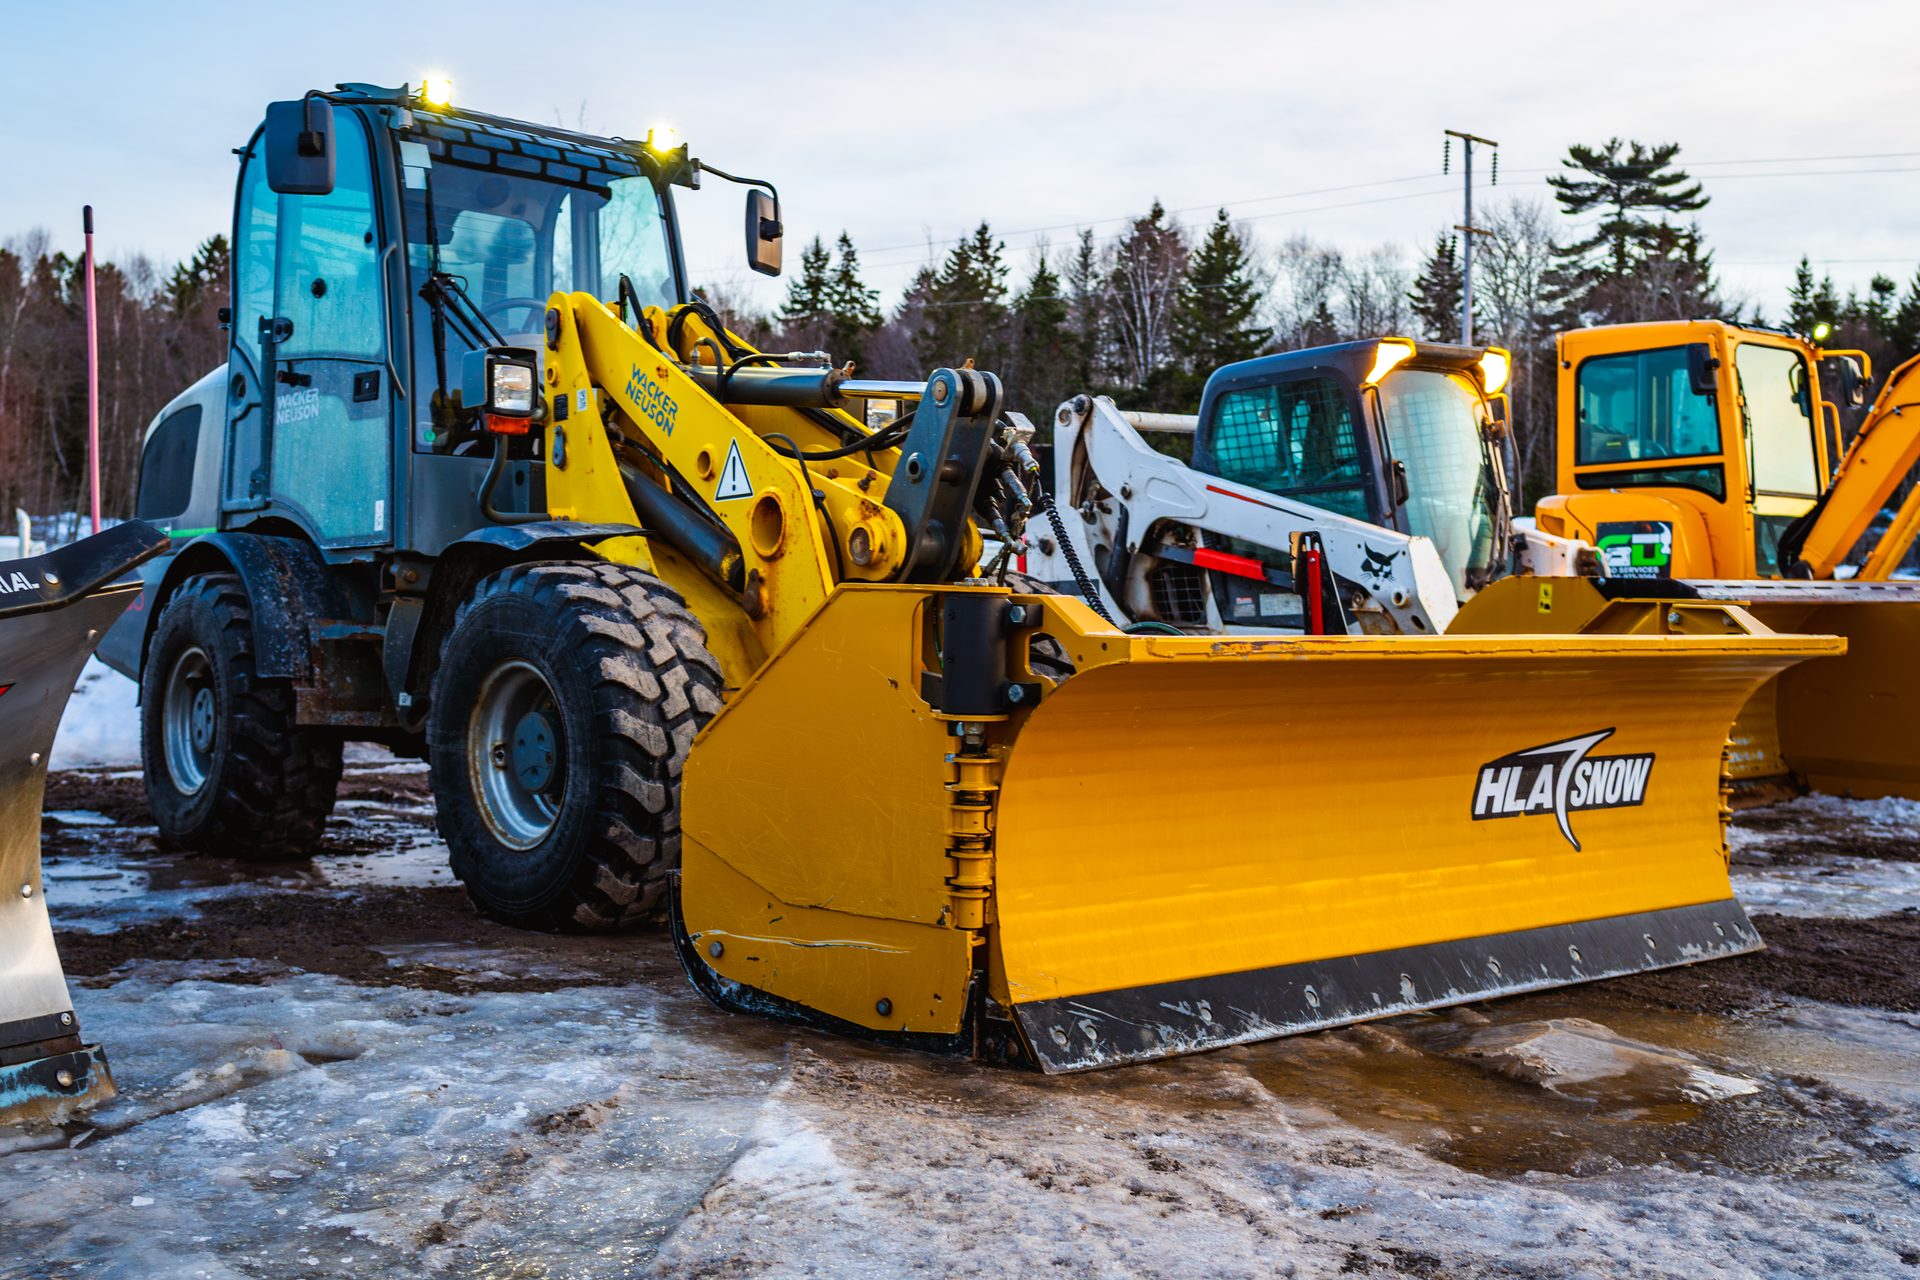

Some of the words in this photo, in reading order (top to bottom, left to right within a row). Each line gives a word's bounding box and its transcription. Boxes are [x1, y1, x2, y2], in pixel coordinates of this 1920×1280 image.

[276, 387, 319, 410] WACKER
[625, 380, 675, 437] NEUSON
[632, 362, 679, 421] WACKER
[276, 403, 319, 425] NEUSON
[1619, 566, 1659, 574] SERVICES
[1474, 763, 1554, 816] HLA
[1570, 756, 1653, 808] SNOW
